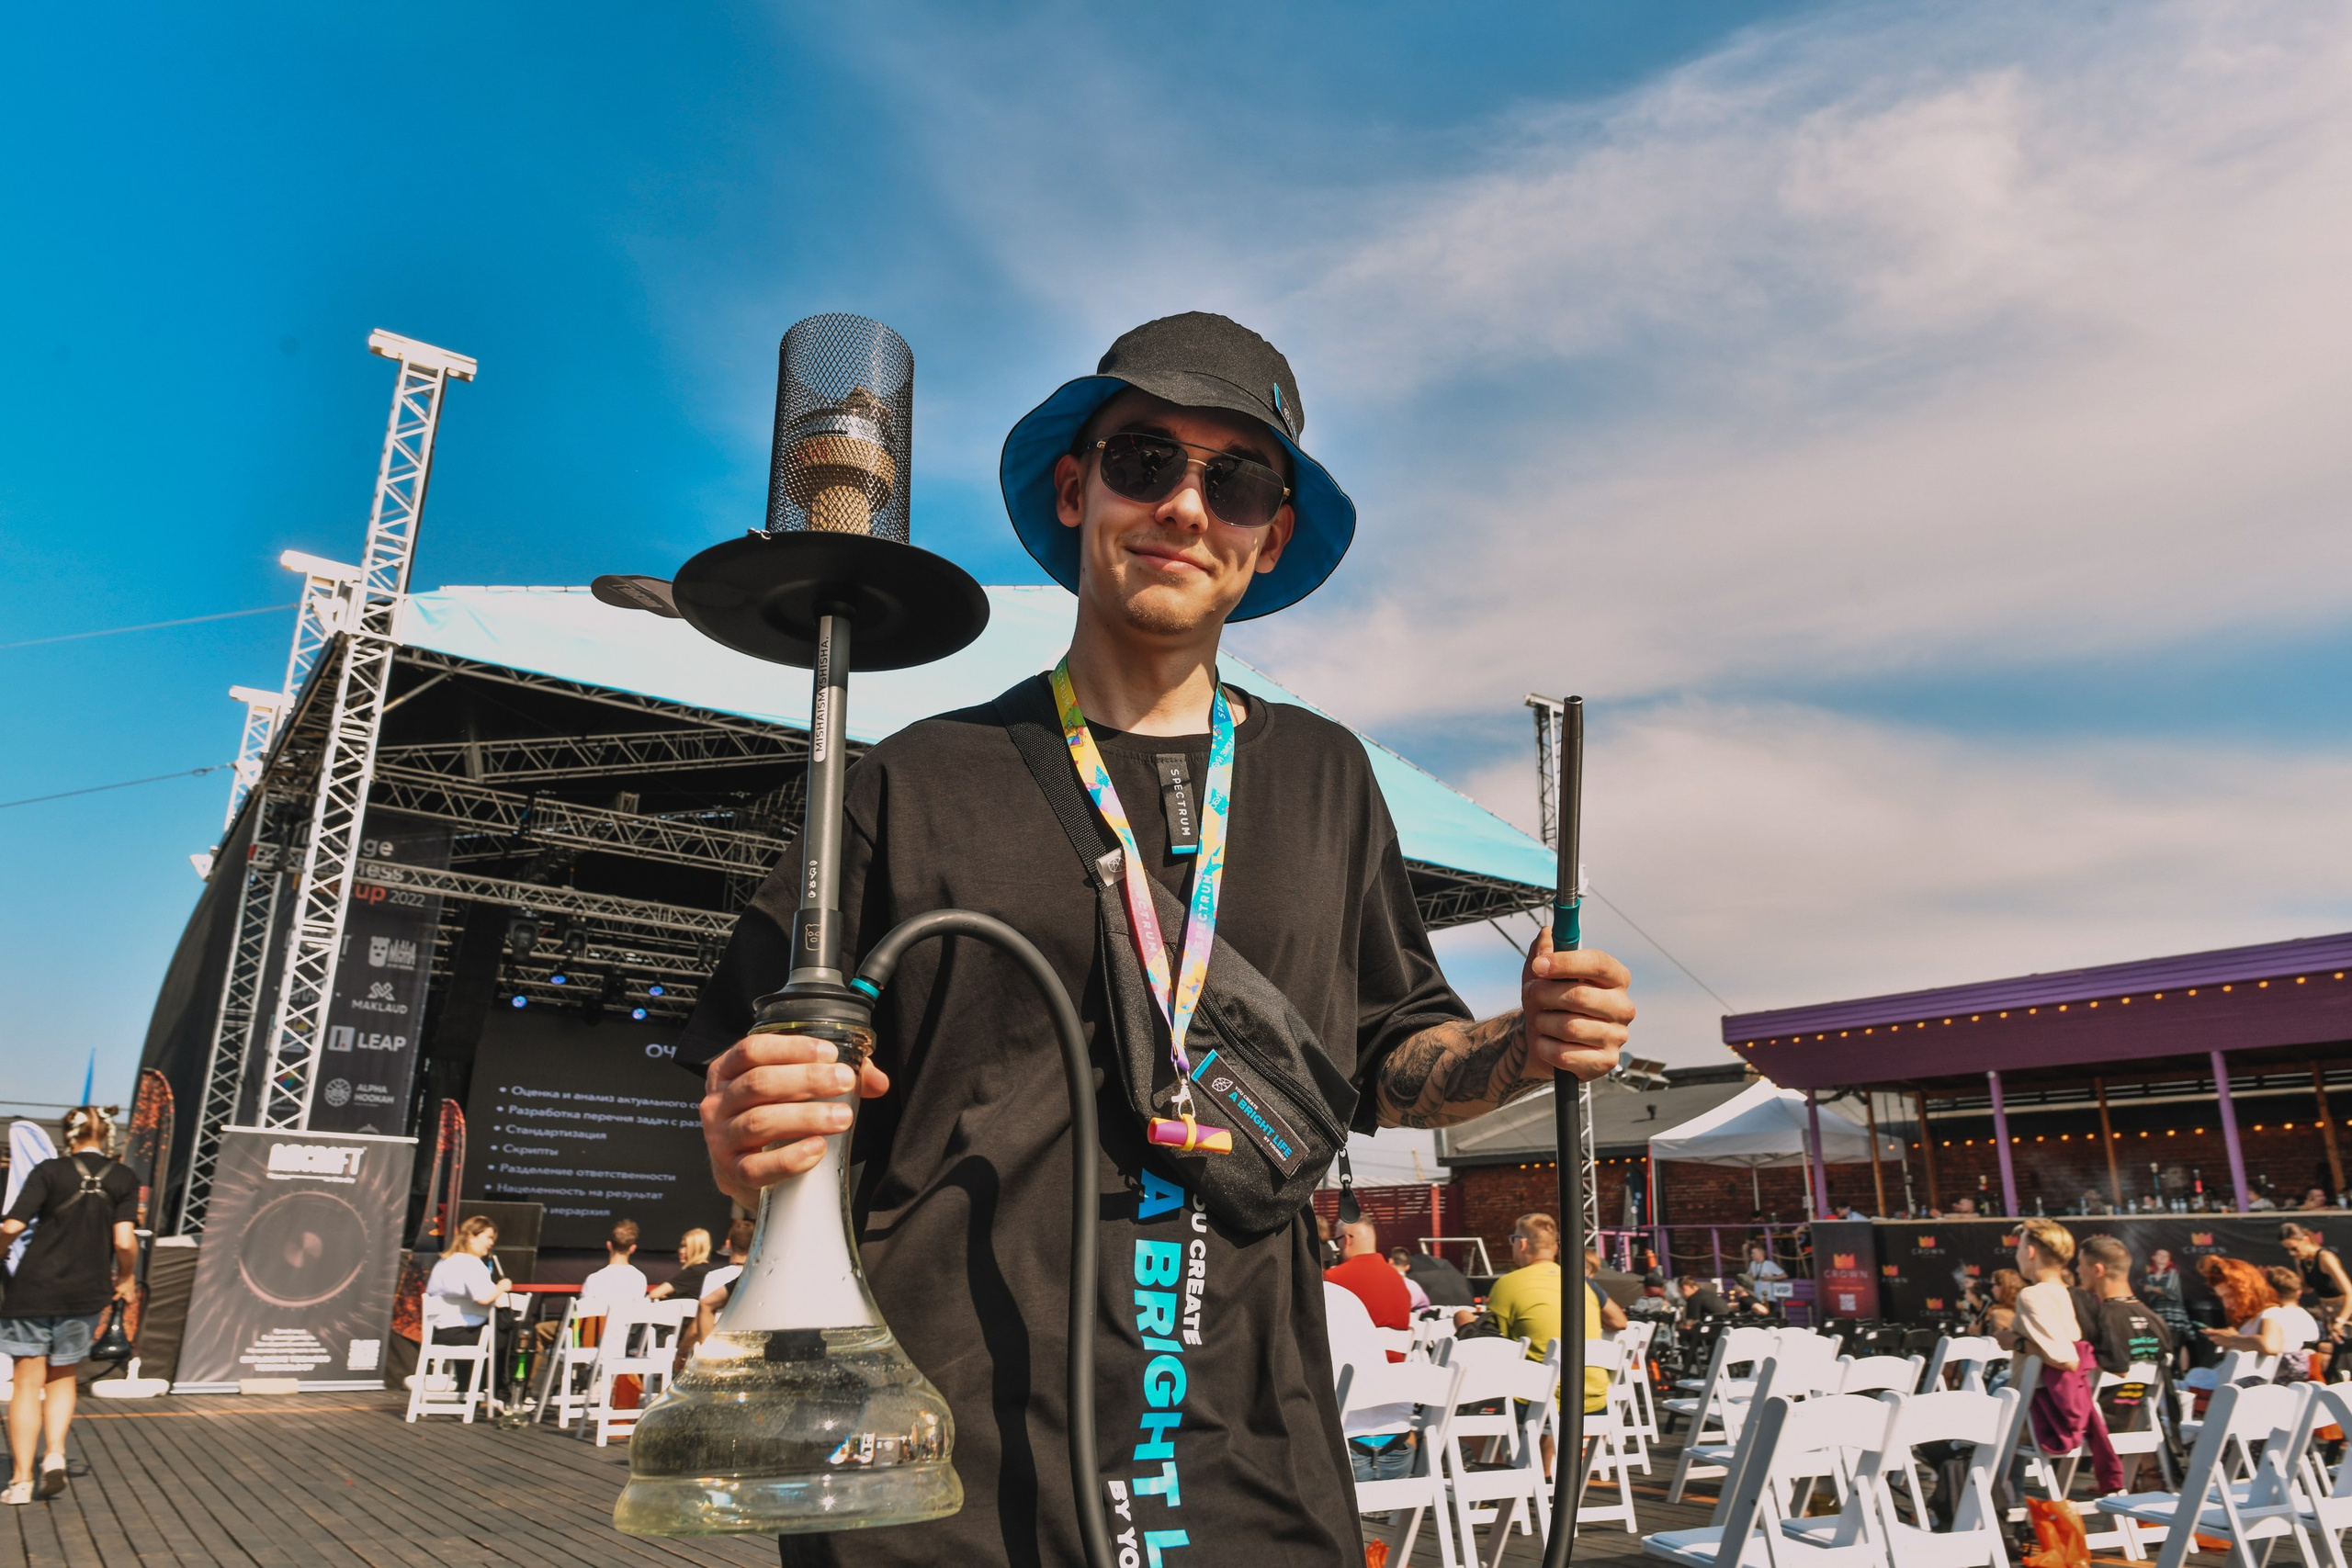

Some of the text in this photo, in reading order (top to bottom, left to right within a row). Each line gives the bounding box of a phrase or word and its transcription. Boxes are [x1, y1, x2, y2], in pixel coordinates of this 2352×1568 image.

[1170, 768, 1191, 837] SPECTRUM
[389, 889, 425, 908] 2022
[1193, 874, 1214, 949] SPECTRUM
[351, 999, 409, 1014] MAKLAUD
[356, 1032, 407, 1052] LEAP
[354, 1093, 395, 1104] HOOKAH
[356, 1083, 388, 1094] ALPHA
[511, 1086, 560, 1098] Оценка
[573, 1093, 615, 1102] анализ
[616, 1096, 688, 1108] актуального
[1235, 1086, 1259, 1111] YOU CREATE
[508, 1105, 582, 1118] Разработка
[637, 1115, 669, 1125] задач
[1228, 1091, 1294, 1158] A BRIGHT LIFE
[505, 1123, 607, 1140] Стандартизация
[503, 1143, 559, 1156] Скрипты
[499, 1163, 676, 1181] Разделение ответственности
[496, 1182, 586, 1196] Нацеленность
[605, 1190, 663, 1201] результат
[1137, 1168, 1184, 1220] A
[550, 1207, 611, 1217] иерархия
[1182, 1193, 1207, 1346] OU CREATE
[1824, 1269, 1869, 1279] CROWN
[1134, 1238, 1186, 1507] BRIGHT
[1108, 1481, 1132, 1522] BY
